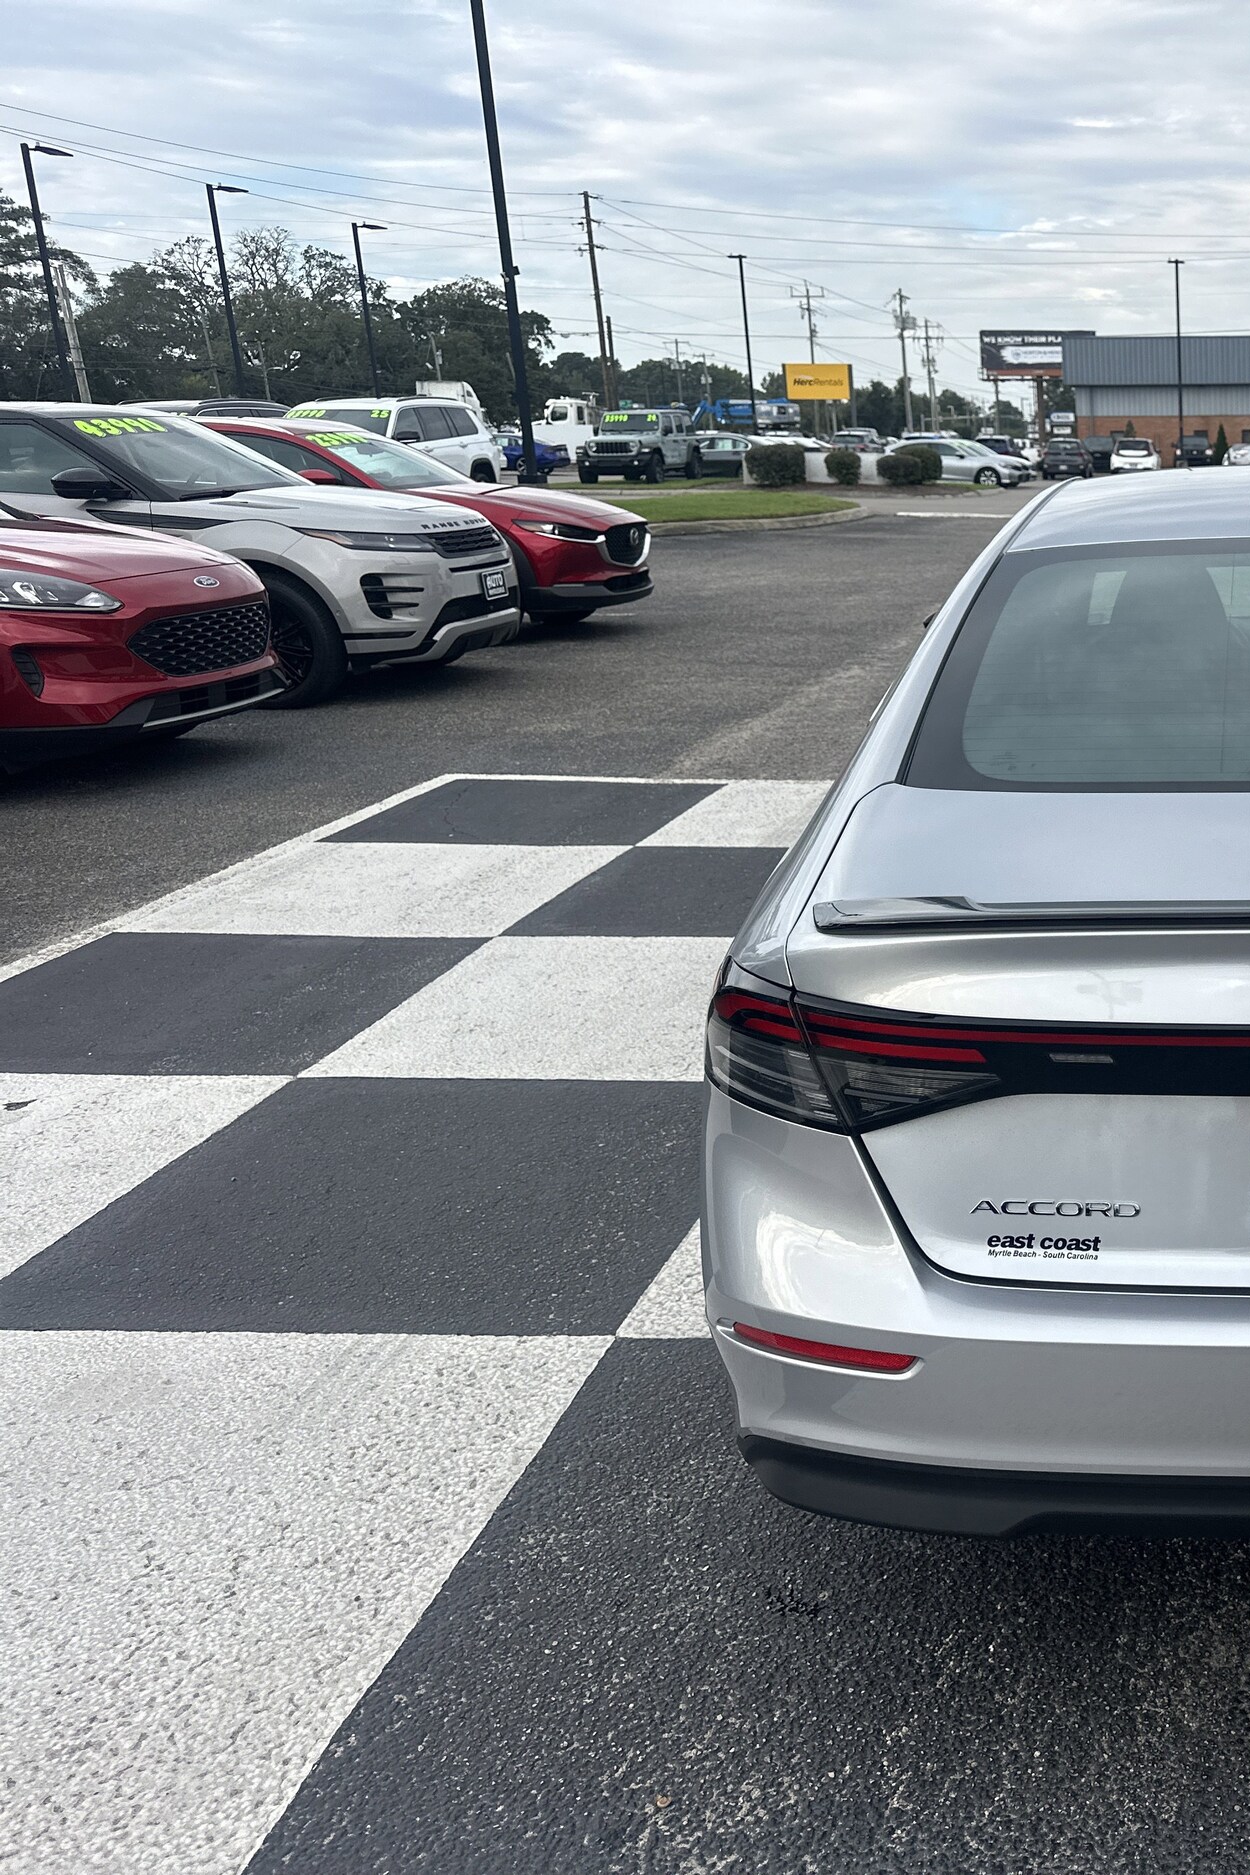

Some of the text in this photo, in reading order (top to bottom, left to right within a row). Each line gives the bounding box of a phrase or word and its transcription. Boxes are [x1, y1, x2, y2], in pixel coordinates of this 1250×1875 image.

[997, 336, 1023, 344] KNOW
[371, 409, 389, 418] 25
[74, 418, 168, 437] 43990
[486, 574, 504, 589] AUTO
[969, 1199, 1142, 1218] ACCORD
[987, 1233, 1101, 1251] east coast
[988, 1249, 1012, 1258] Myrtle
[1013, 1250, 1037, 1258] Beach
[1042, 1251, 1065, 1259] South
[1066, 1252, 1099, 1260] Carolina
